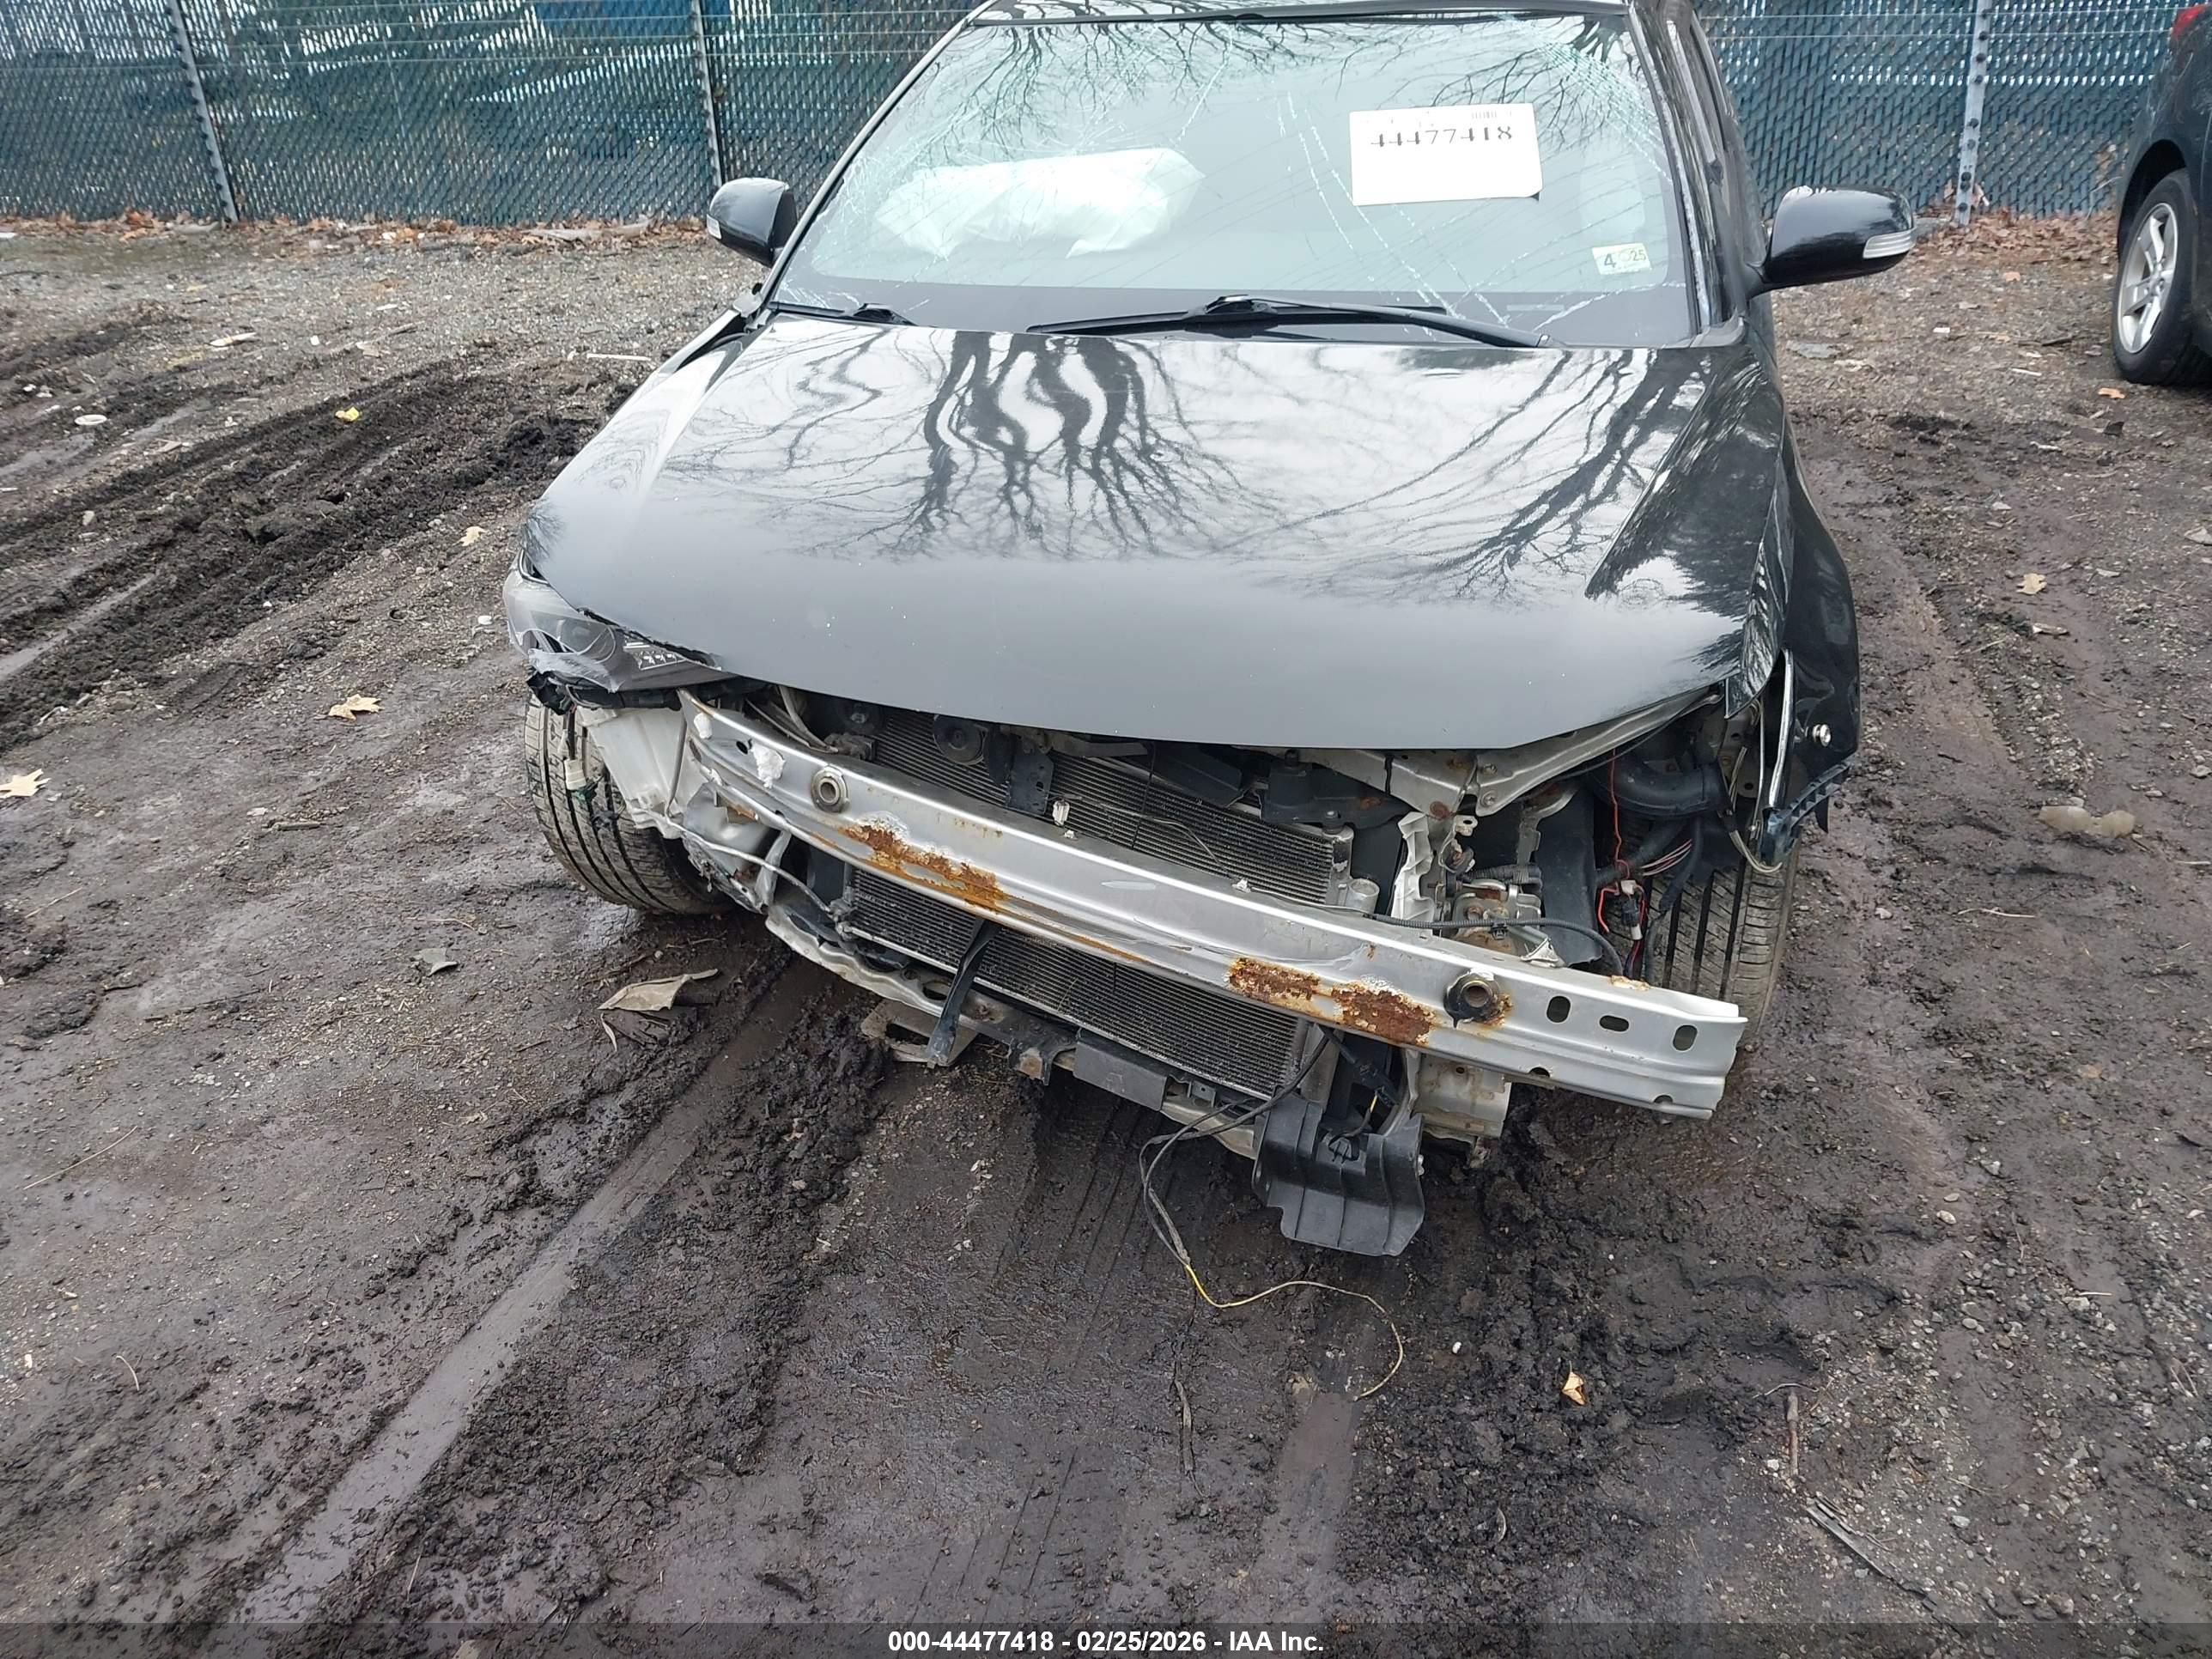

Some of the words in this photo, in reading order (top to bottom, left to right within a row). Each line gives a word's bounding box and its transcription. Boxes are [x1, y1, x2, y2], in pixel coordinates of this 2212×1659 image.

[1370, 126, 1513, 148] 44477418
[1603, 252, 1618, 269] 4
[1630, 249, 1647, 262] 25
